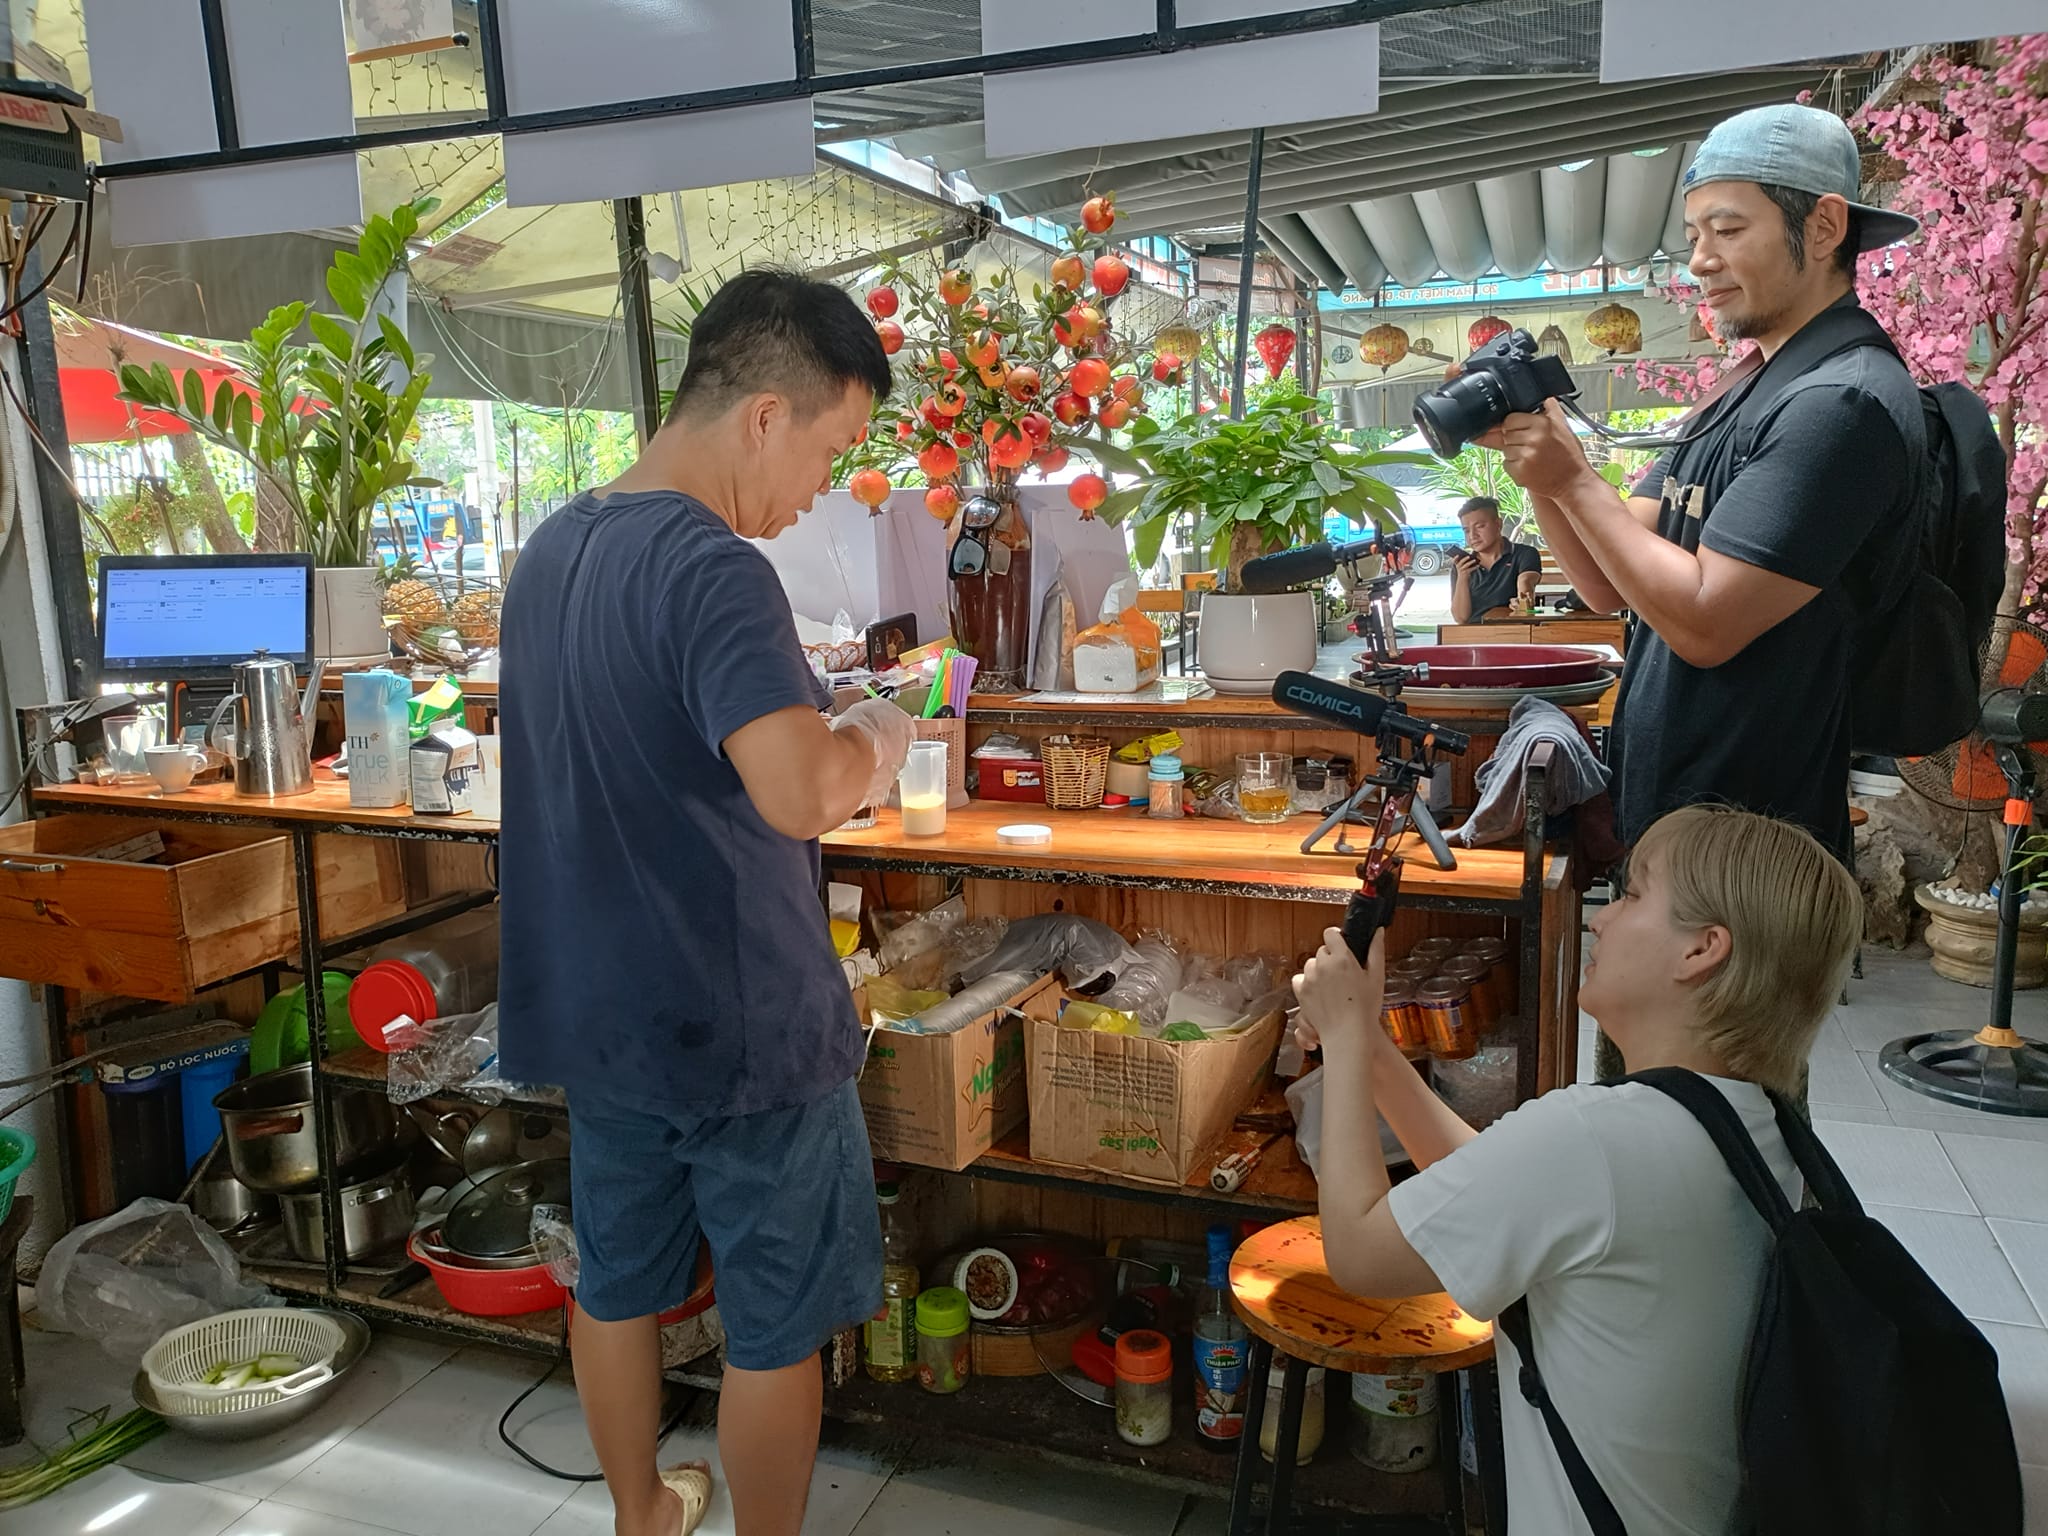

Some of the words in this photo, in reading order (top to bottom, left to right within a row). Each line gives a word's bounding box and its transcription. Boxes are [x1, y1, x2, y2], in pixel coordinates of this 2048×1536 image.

[1286, 685, 1363, 718] COMICA
[347, 735, 369, 749] TH
[349, 752, 389, 769] true
[351, 769, 389, 785] MILK
